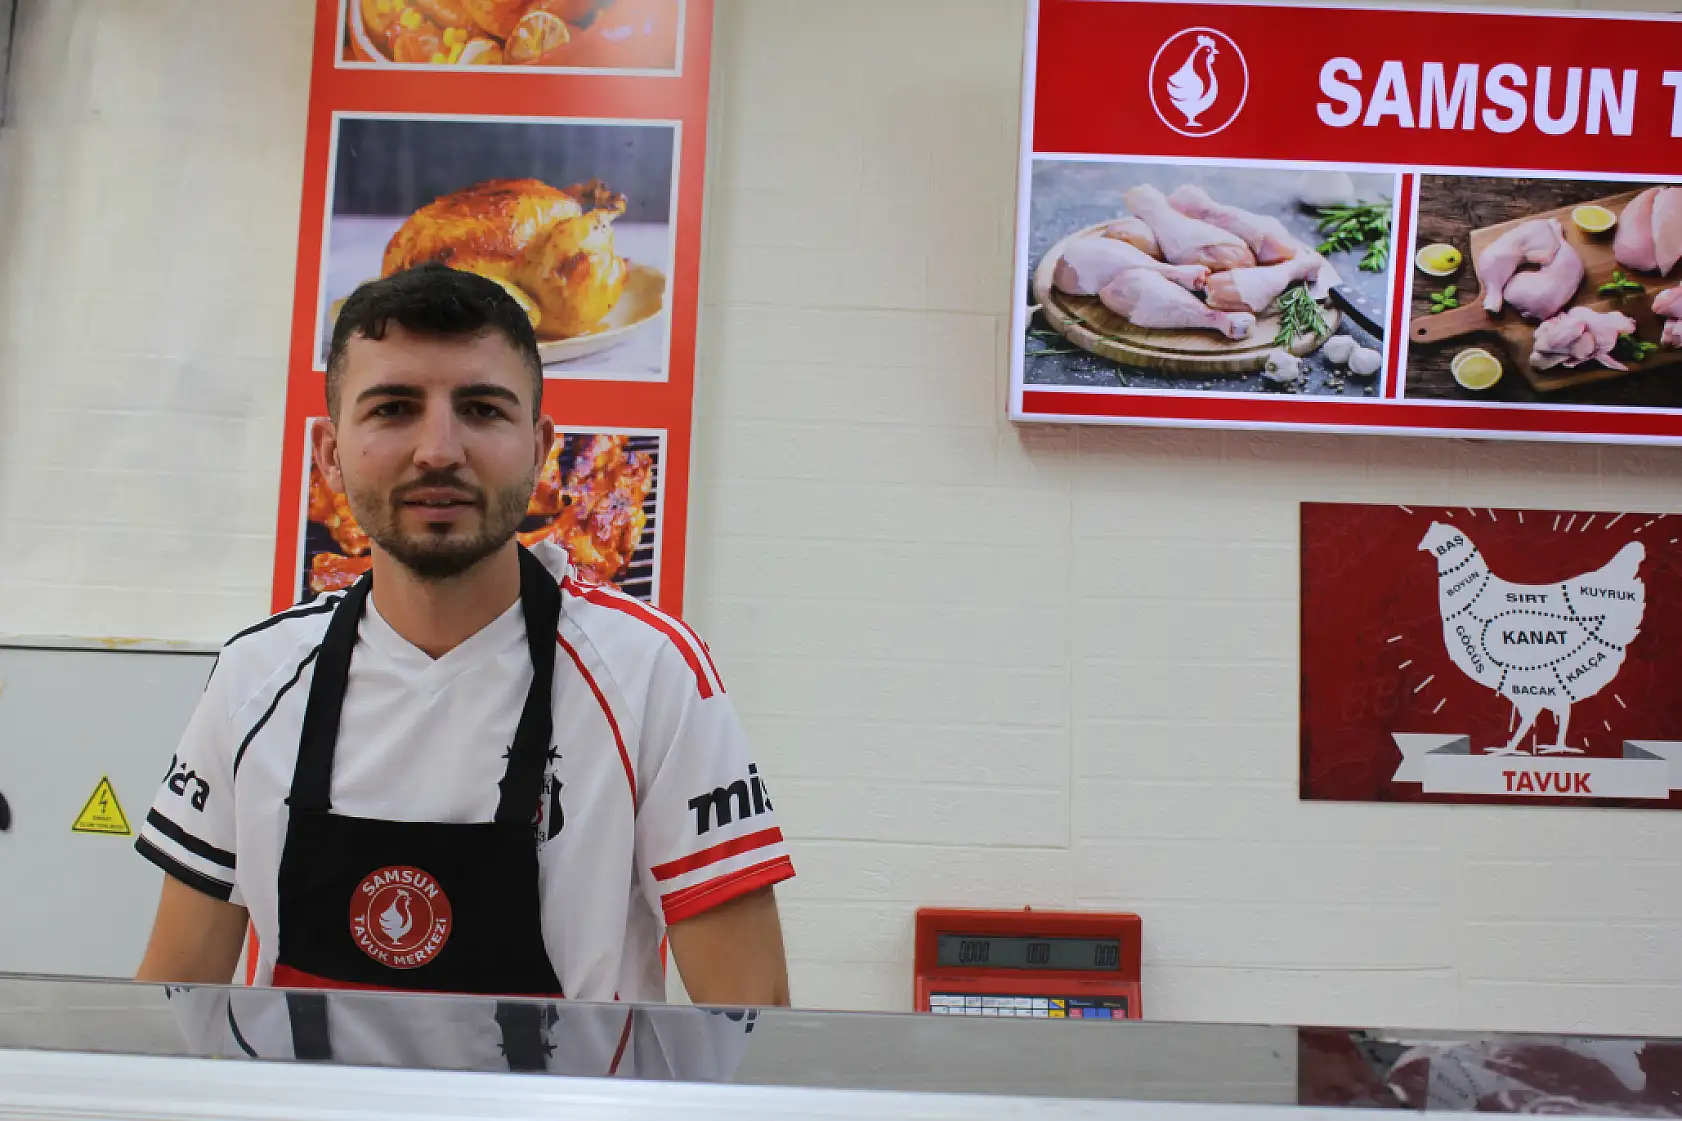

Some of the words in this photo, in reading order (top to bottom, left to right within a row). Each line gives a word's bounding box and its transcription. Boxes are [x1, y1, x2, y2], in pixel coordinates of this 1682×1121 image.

[1316, 56, 1638, 137] SAMSUN
[1437, 535, 1465, 557] BAŞ
[1446, 570, 1480, 597] BOYUN
[1580, 586, 1636, 601] KUYRUK
[1506, 593, 1548, 604] SIRT
[1502, 631, 1567, 646] KANAT
[1566, 651, 1606, 683] KALÇA
[1511, 686, 1556, 697] BACAK
[1502, 770, 1592, 793] TAVUK
[362, 869, 439, 899] SAMSUN
[354, 914, 389, 962] TAVUK
